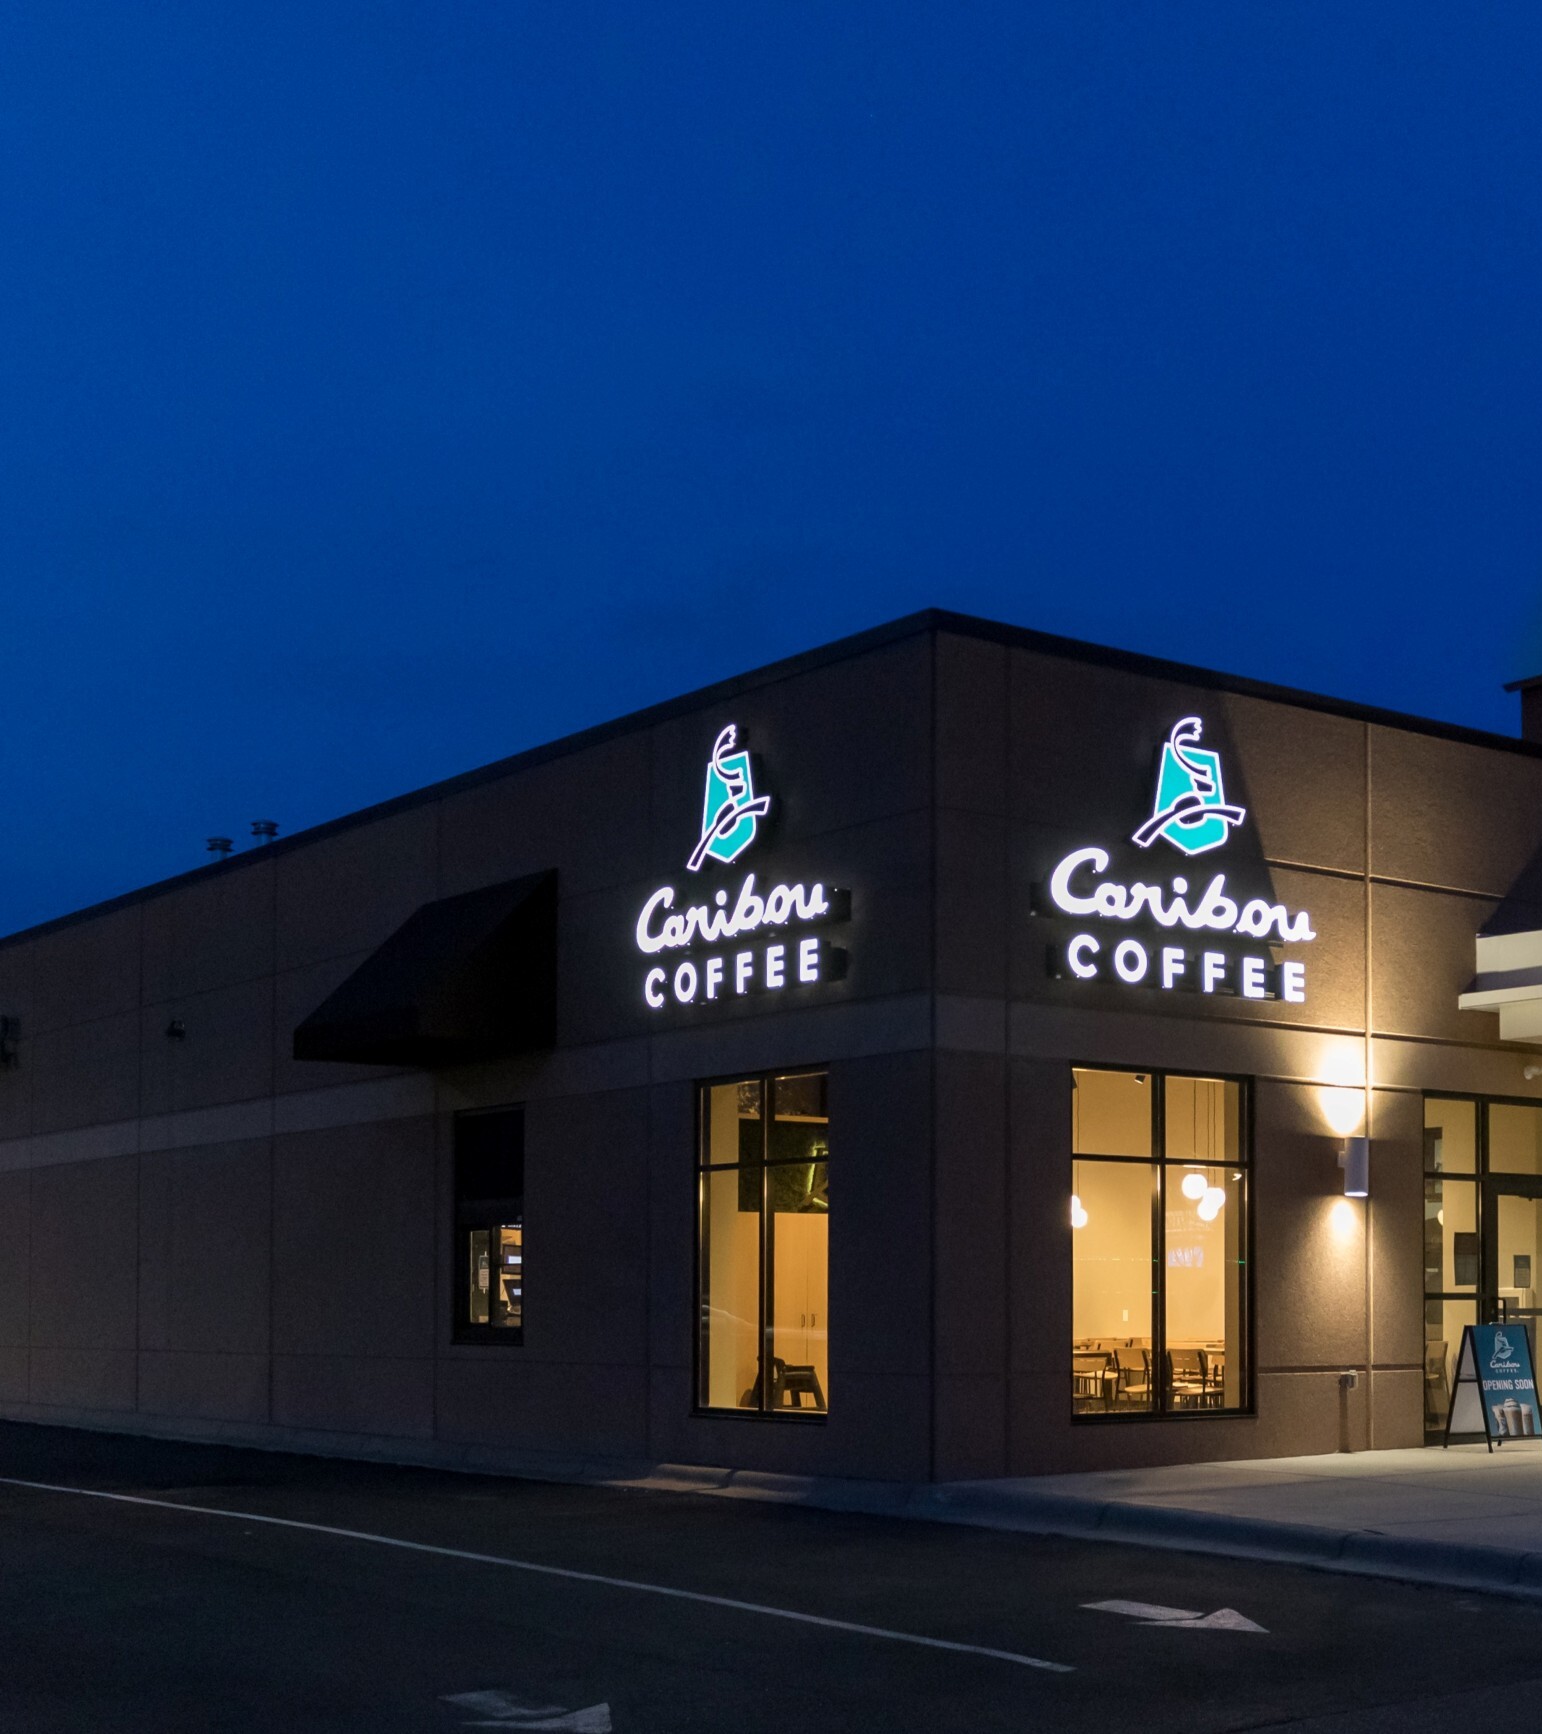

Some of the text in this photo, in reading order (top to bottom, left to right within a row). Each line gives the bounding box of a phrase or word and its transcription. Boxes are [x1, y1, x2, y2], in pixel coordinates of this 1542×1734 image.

[636, 873, 829, 954] Caribou
[1050, 847, 1316, 942] Caribou
[645, 938, 819, 1007] COFFEE
[1067, 934, 1306, 1003] COFFEE
[1482, 1378, 1535, 1391] OPENING SOON
